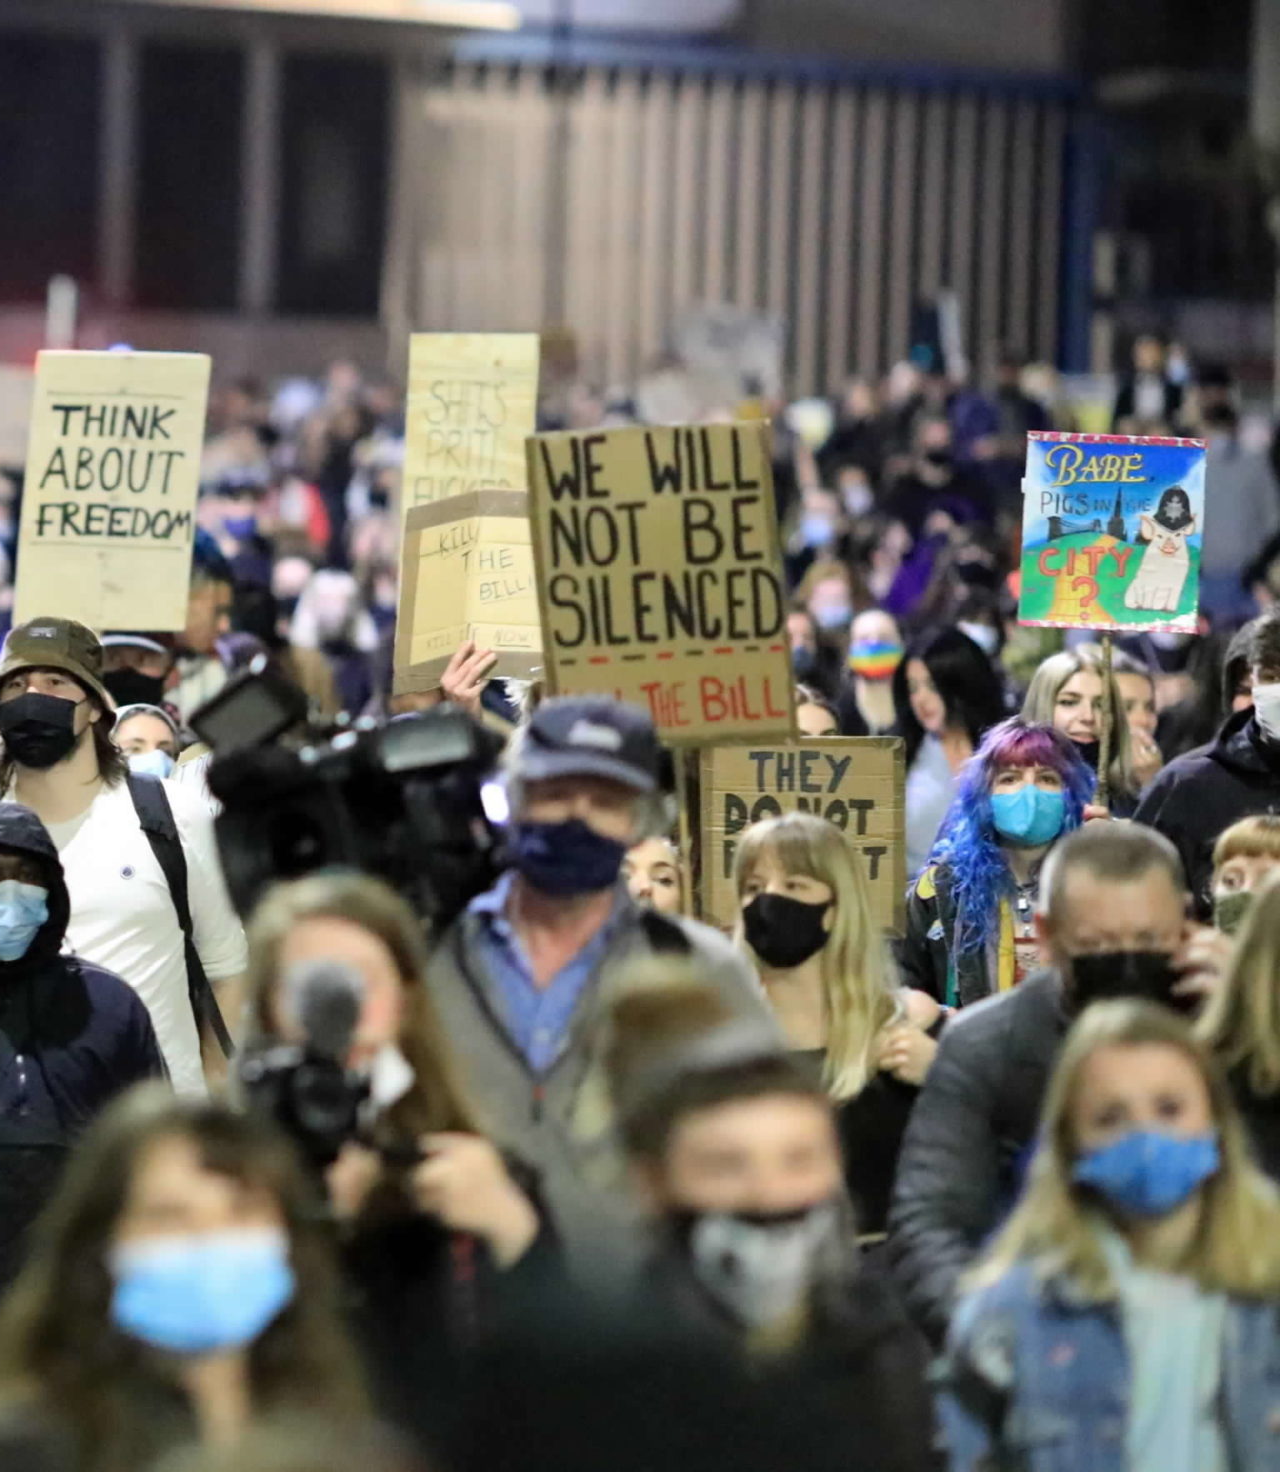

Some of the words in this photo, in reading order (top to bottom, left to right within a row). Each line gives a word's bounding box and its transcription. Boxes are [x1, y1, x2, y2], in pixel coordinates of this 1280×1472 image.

[51, 404, 177, 440] THINK
[38, 446, 185, 495] ABOUT
[540, 434, 610, 502] WE
[644, 427, 760, 495] WILL
[34, 502, 192, 543] FREEDOM
[1040, 490, 1089, 517] PIGS
[549, 500, 648, 568] NOT
[682, 494, 764, 566] BE
[461, 548, 514, 572] THE
[1038, 546, 1135, 578] CITY
[549, 567, 784, 648] SILENCED
[640, 681, 690, 727] THE
[699, 675, 788, 722] BILL
[749, 750, 852, 793] THEY
[724, 793, 782, 836] DO
